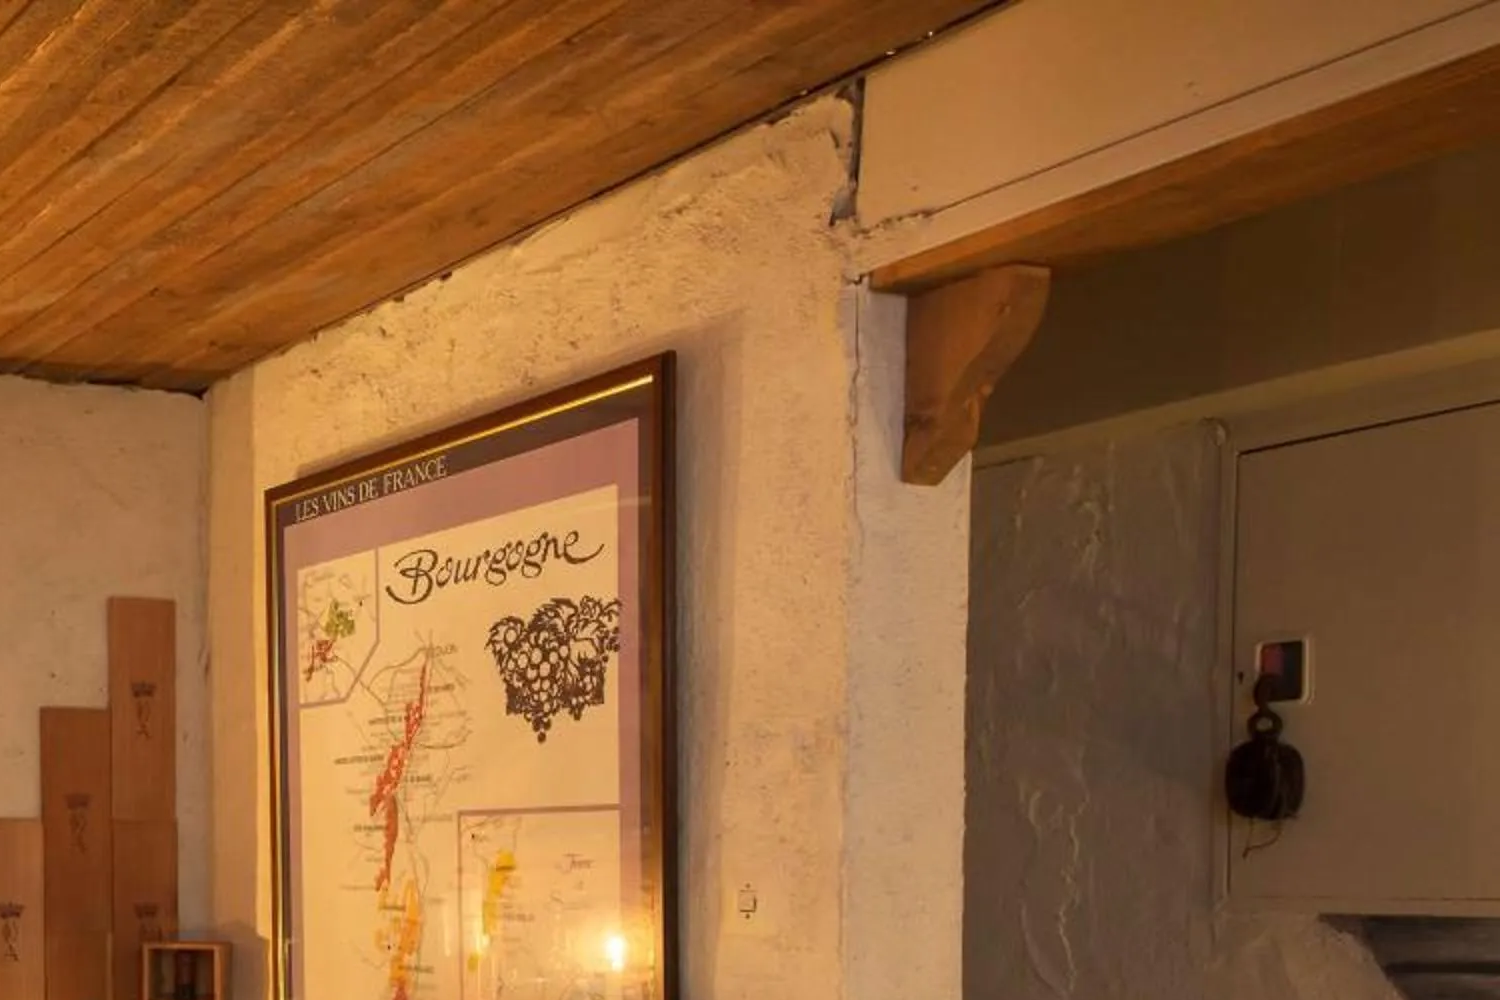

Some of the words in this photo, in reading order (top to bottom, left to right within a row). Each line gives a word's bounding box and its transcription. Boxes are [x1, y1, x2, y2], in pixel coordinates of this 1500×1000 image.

[295, 497, 319, 521] LES
[323, 485, 355, 512] VINS
[359, 477, 378, 502] DE
[383, 455, 448, 494] FRANCE
[385, 530, 605, 605] Bourgogne
